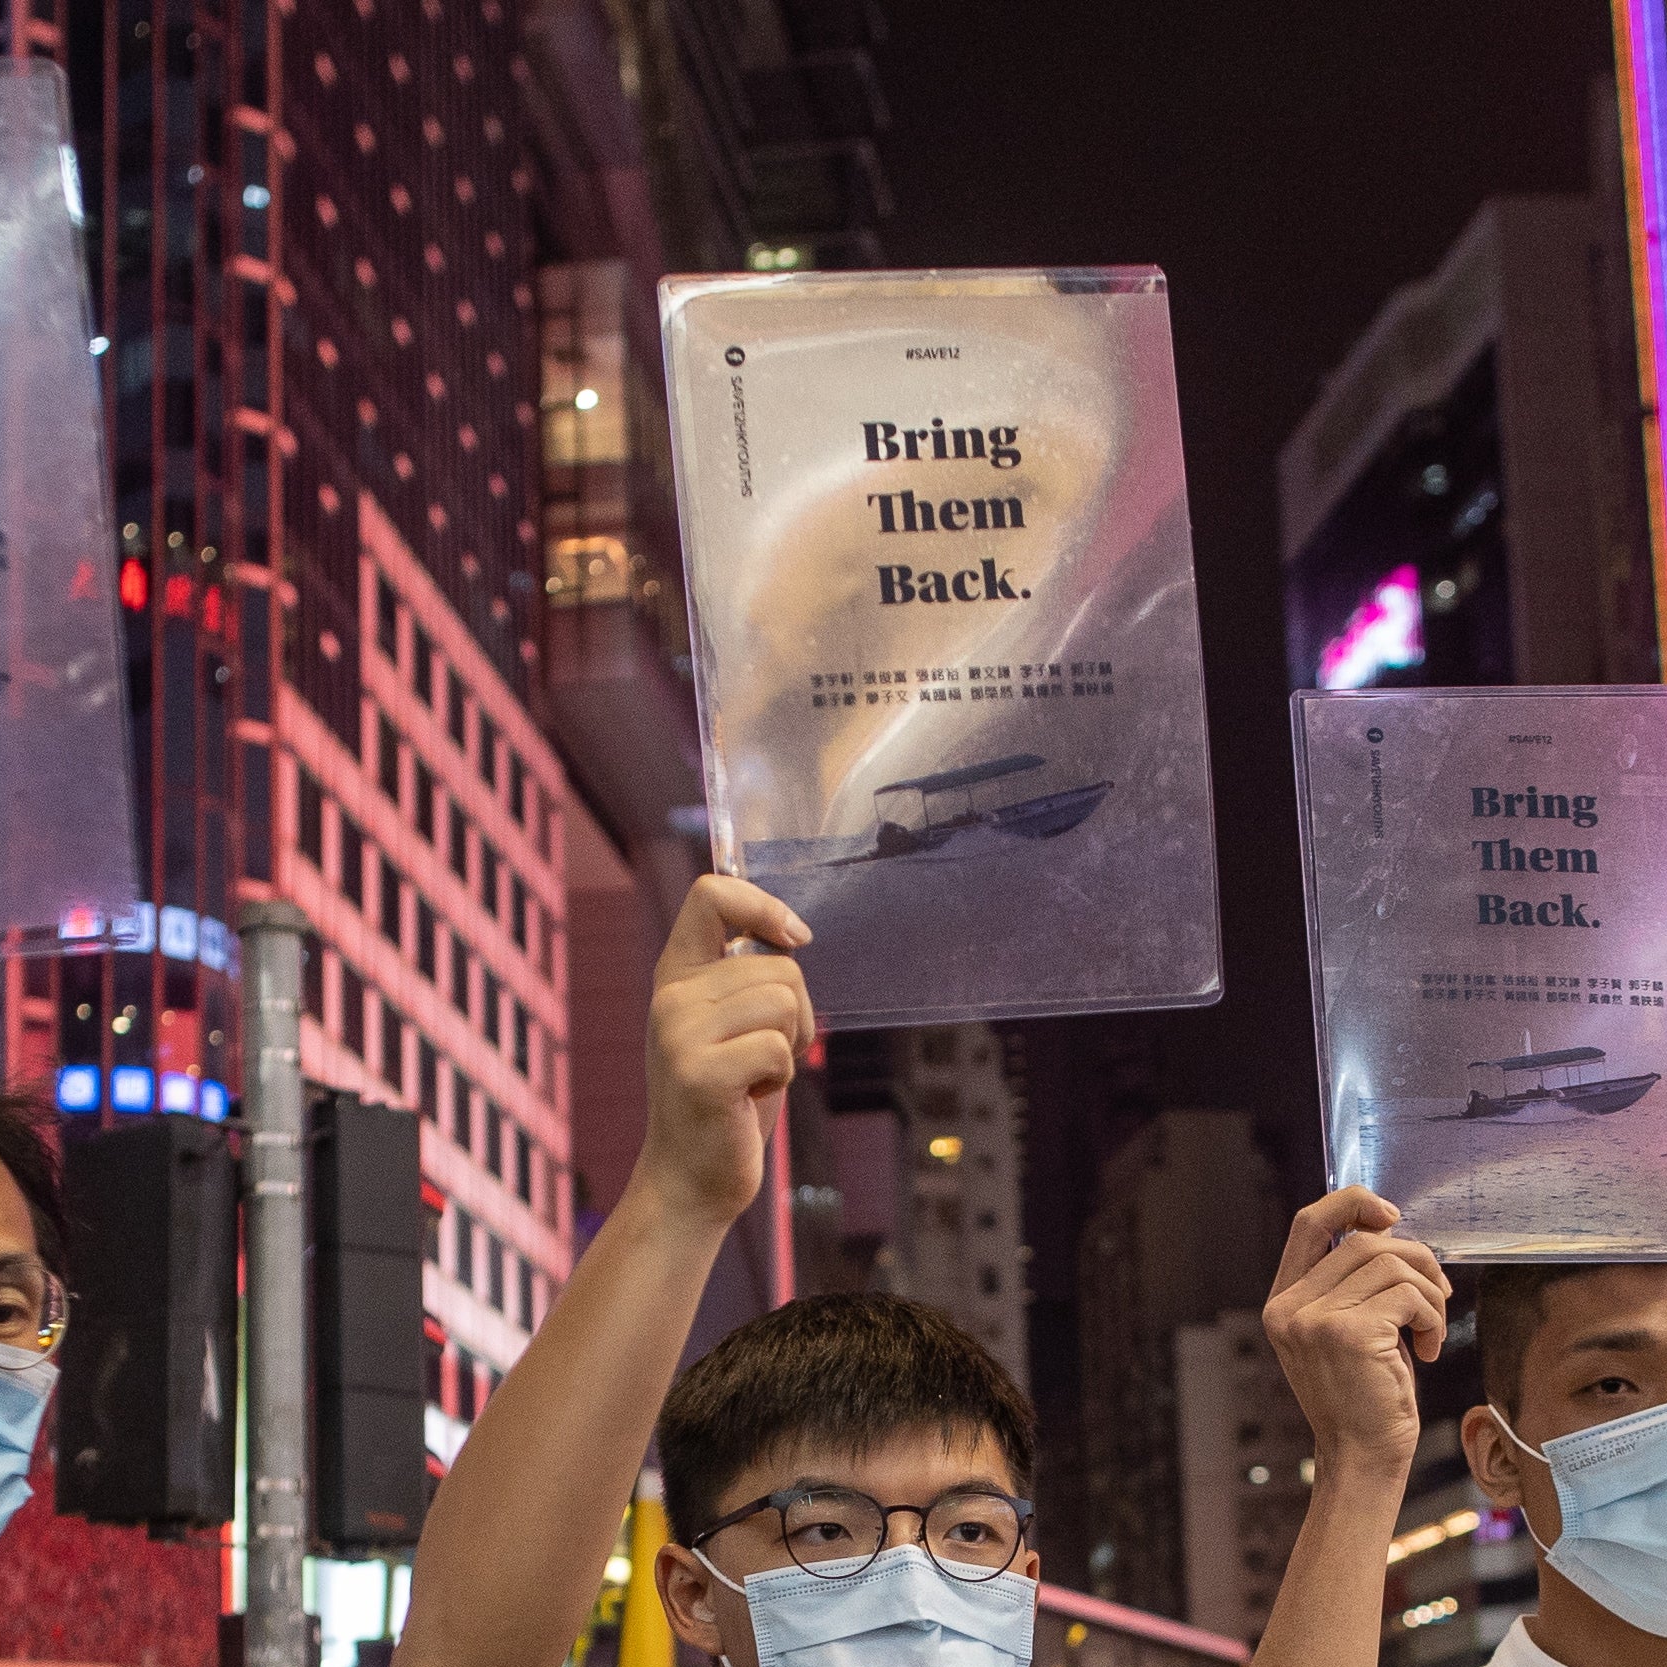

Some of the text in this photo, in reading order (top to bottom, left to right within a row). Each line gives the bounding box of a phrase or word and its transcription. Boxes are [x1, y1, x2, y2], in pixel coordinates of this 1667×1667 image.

[906, 347, 960, 360] #SAVE12
[861, 417, 1022, 468] Bring
[868, 490, 1025, 534] Them
[876, 557, 1032, 606] Back.
[1471, 786, 1598, 827] Bring
[1472, 839, 1599, 874] Them
[1477, 893, 1601, 929] Back.
